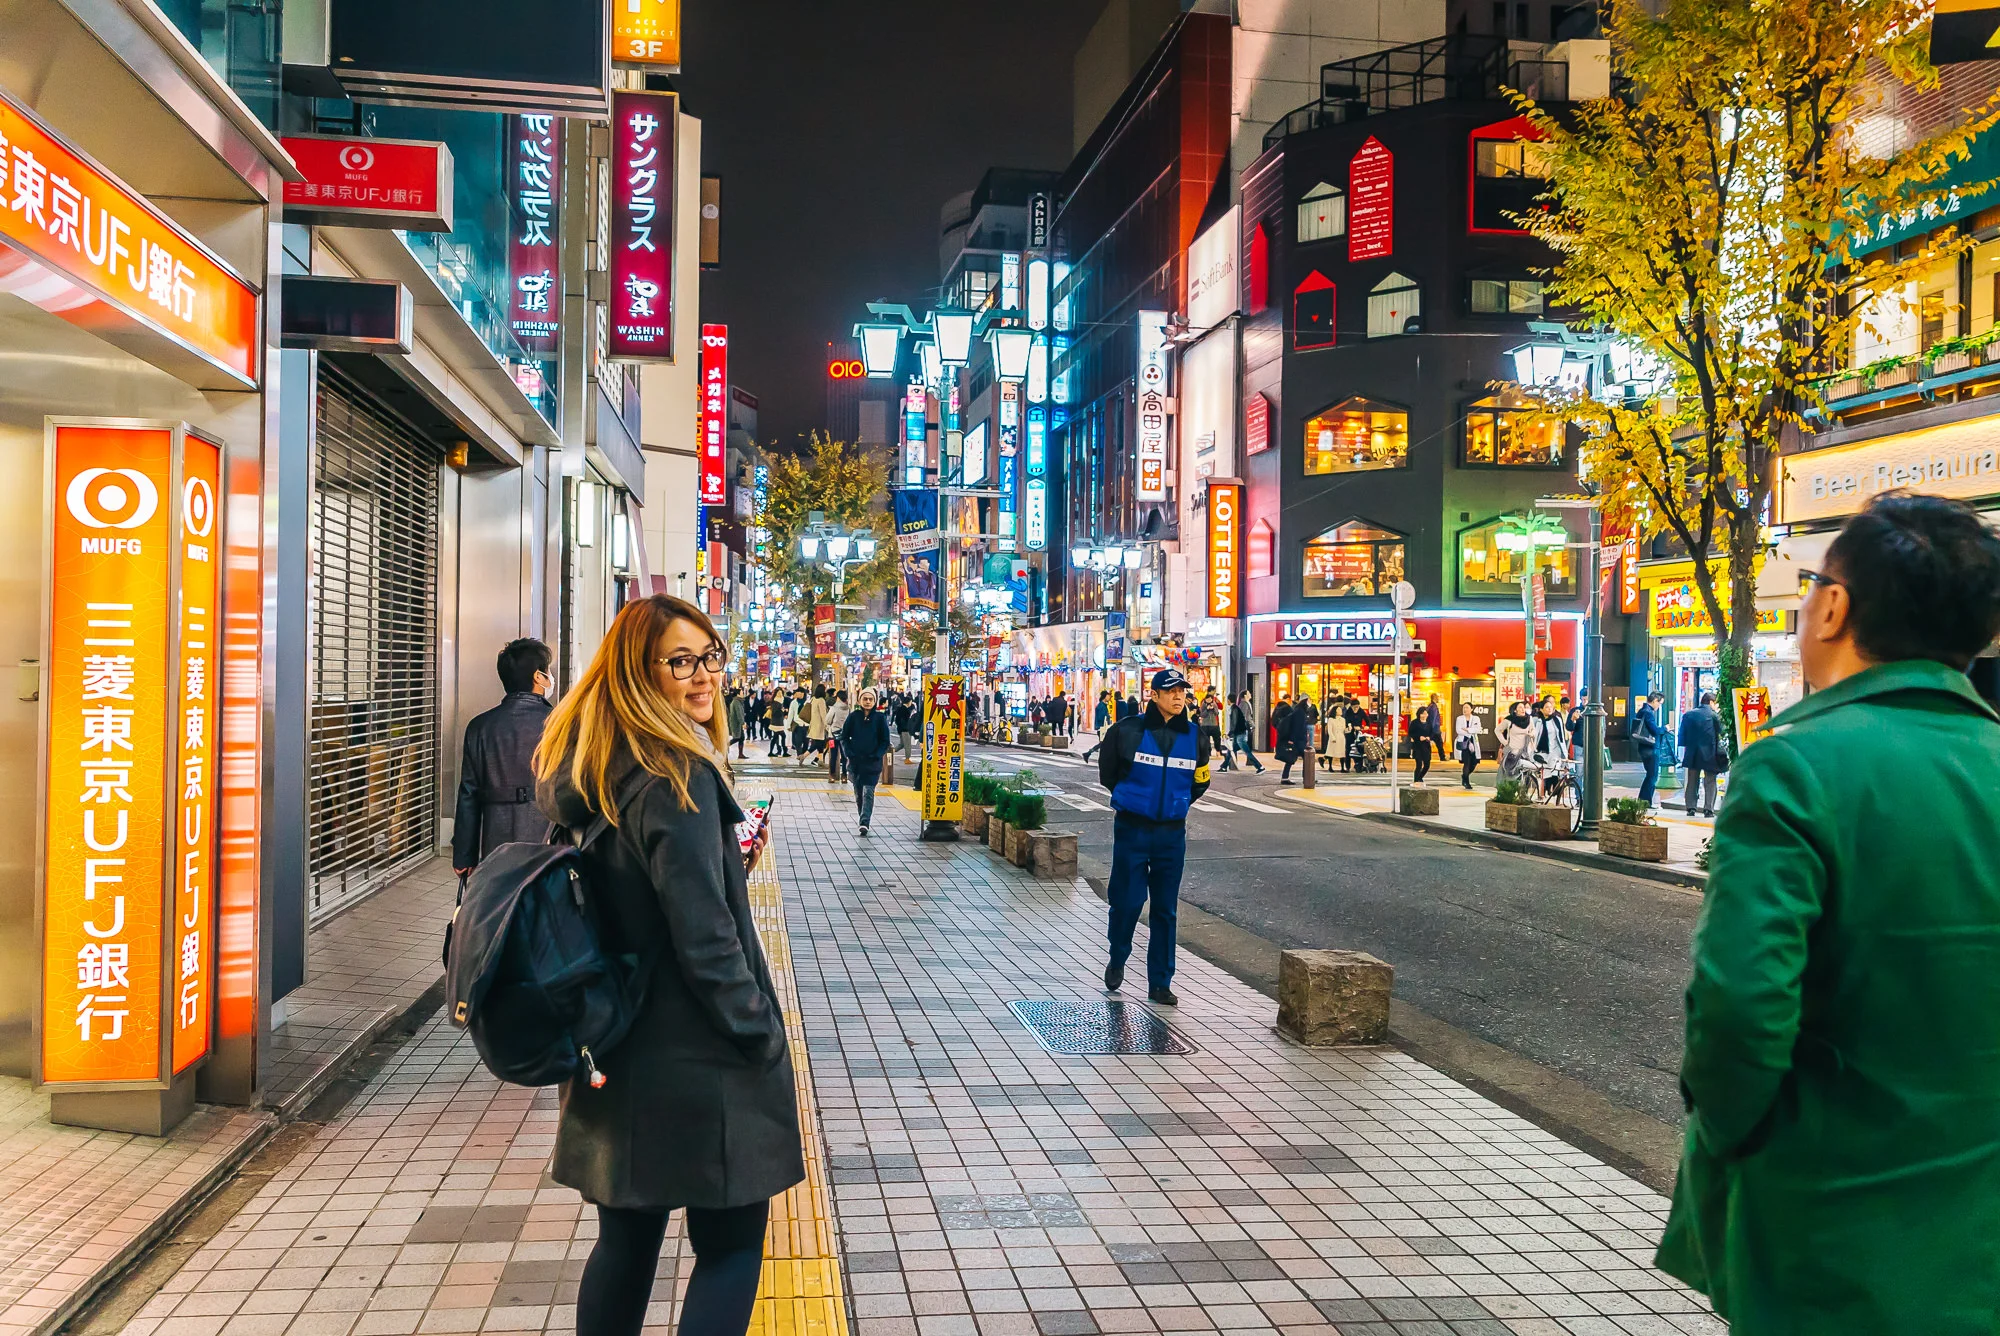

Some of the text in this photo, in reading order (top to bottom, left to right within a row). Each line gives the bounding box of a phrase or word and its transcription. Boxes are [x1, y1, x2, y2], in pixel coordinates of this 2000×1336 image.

[617, 27, 674, 37] CONTACT
[629, 39, 663, 58] 3F
[288, 182, 423, 205] 三菱東京UFJ銀行
[344, 173, 369, 181] MUFG
[628, 113, 659, 252] サングラス
[0, 130, 197, 323] 東京UFJ銀行
[1200, 253, 1234, 290] SoftBank
[617, 325, 664, 336] WASHIN
[626, 334, 655, 342] ANNEX
[708, 367, 721, 412] メガネ
[1142, 389, 1163, 454] 高田屋
[1811, 448, 2000, 501] Beer Restaura
[902, 518, 929, 532] STOP!
[81, 537, 142, 556] MUFG
[1215, 489, 1233, 612] LOTTERIA
[1283, 622, 1397, 641] LOTTERIA
[1501, 674, 1523, 684] ポテト
[935, 733, 948, 818] 客引きに注意!!
[949, 718, 961, 804] 路上の居酒屋の
[75, 602, 135, 1042] 三菱東京UFJ銀行
[180, 606, 206, 1029] 三菱東京UFJ銀行
